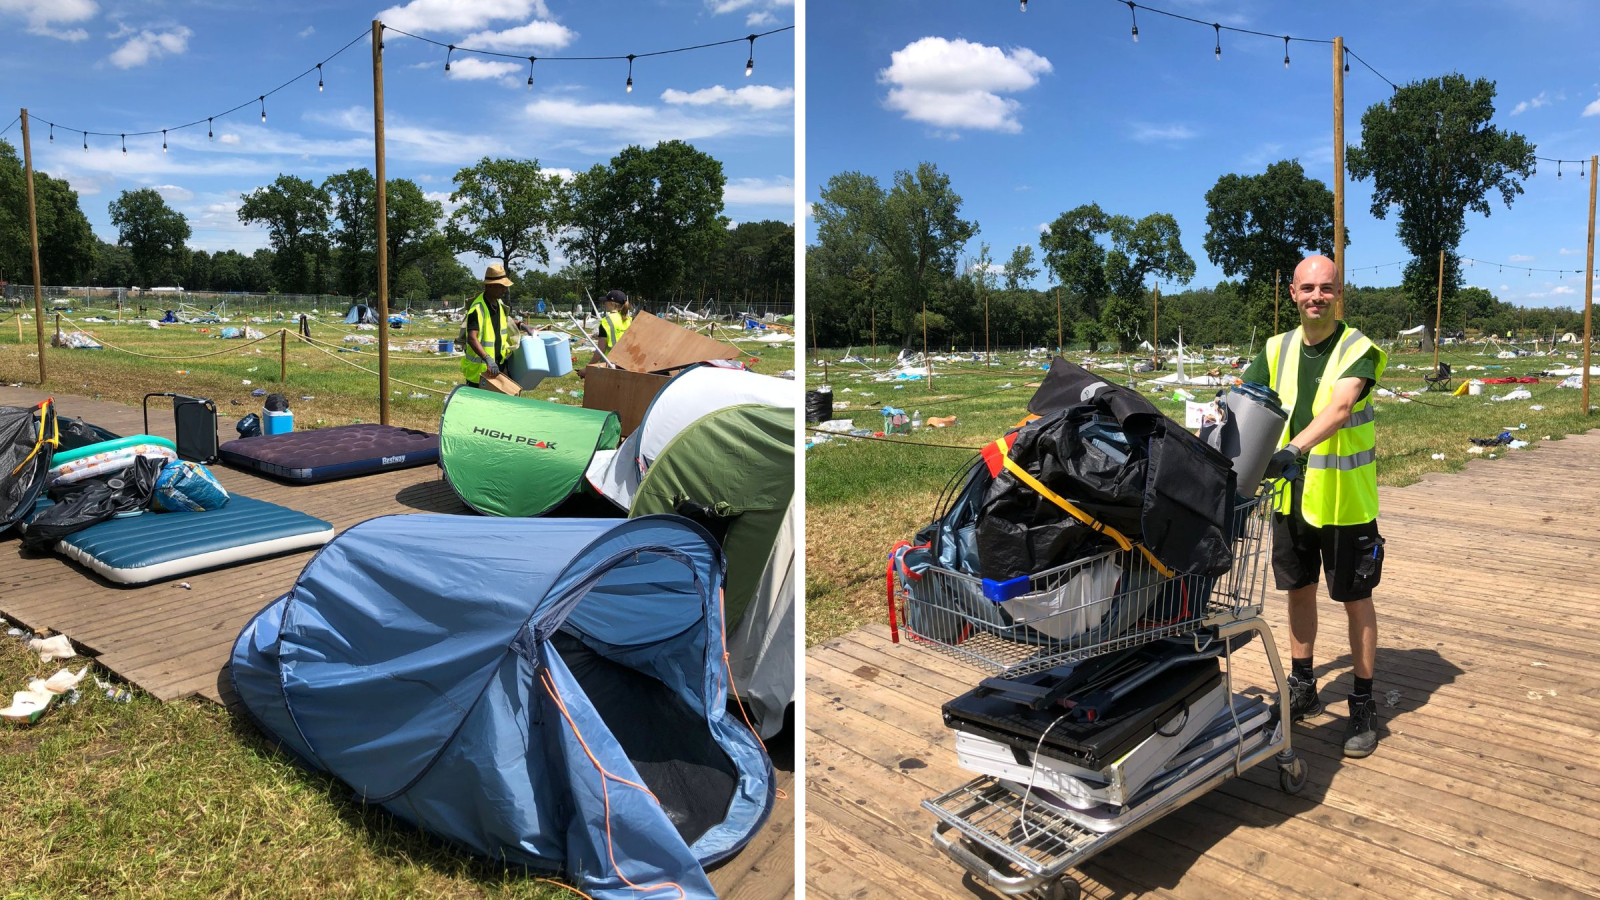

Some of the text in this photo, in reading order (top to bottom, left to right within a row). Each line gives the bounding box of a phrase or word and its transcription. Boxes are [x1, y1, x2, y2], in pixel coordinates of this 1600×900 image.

[473, 426, 557, 450] HIGH PEAK
[382, 455, 406, 465] Bestway
